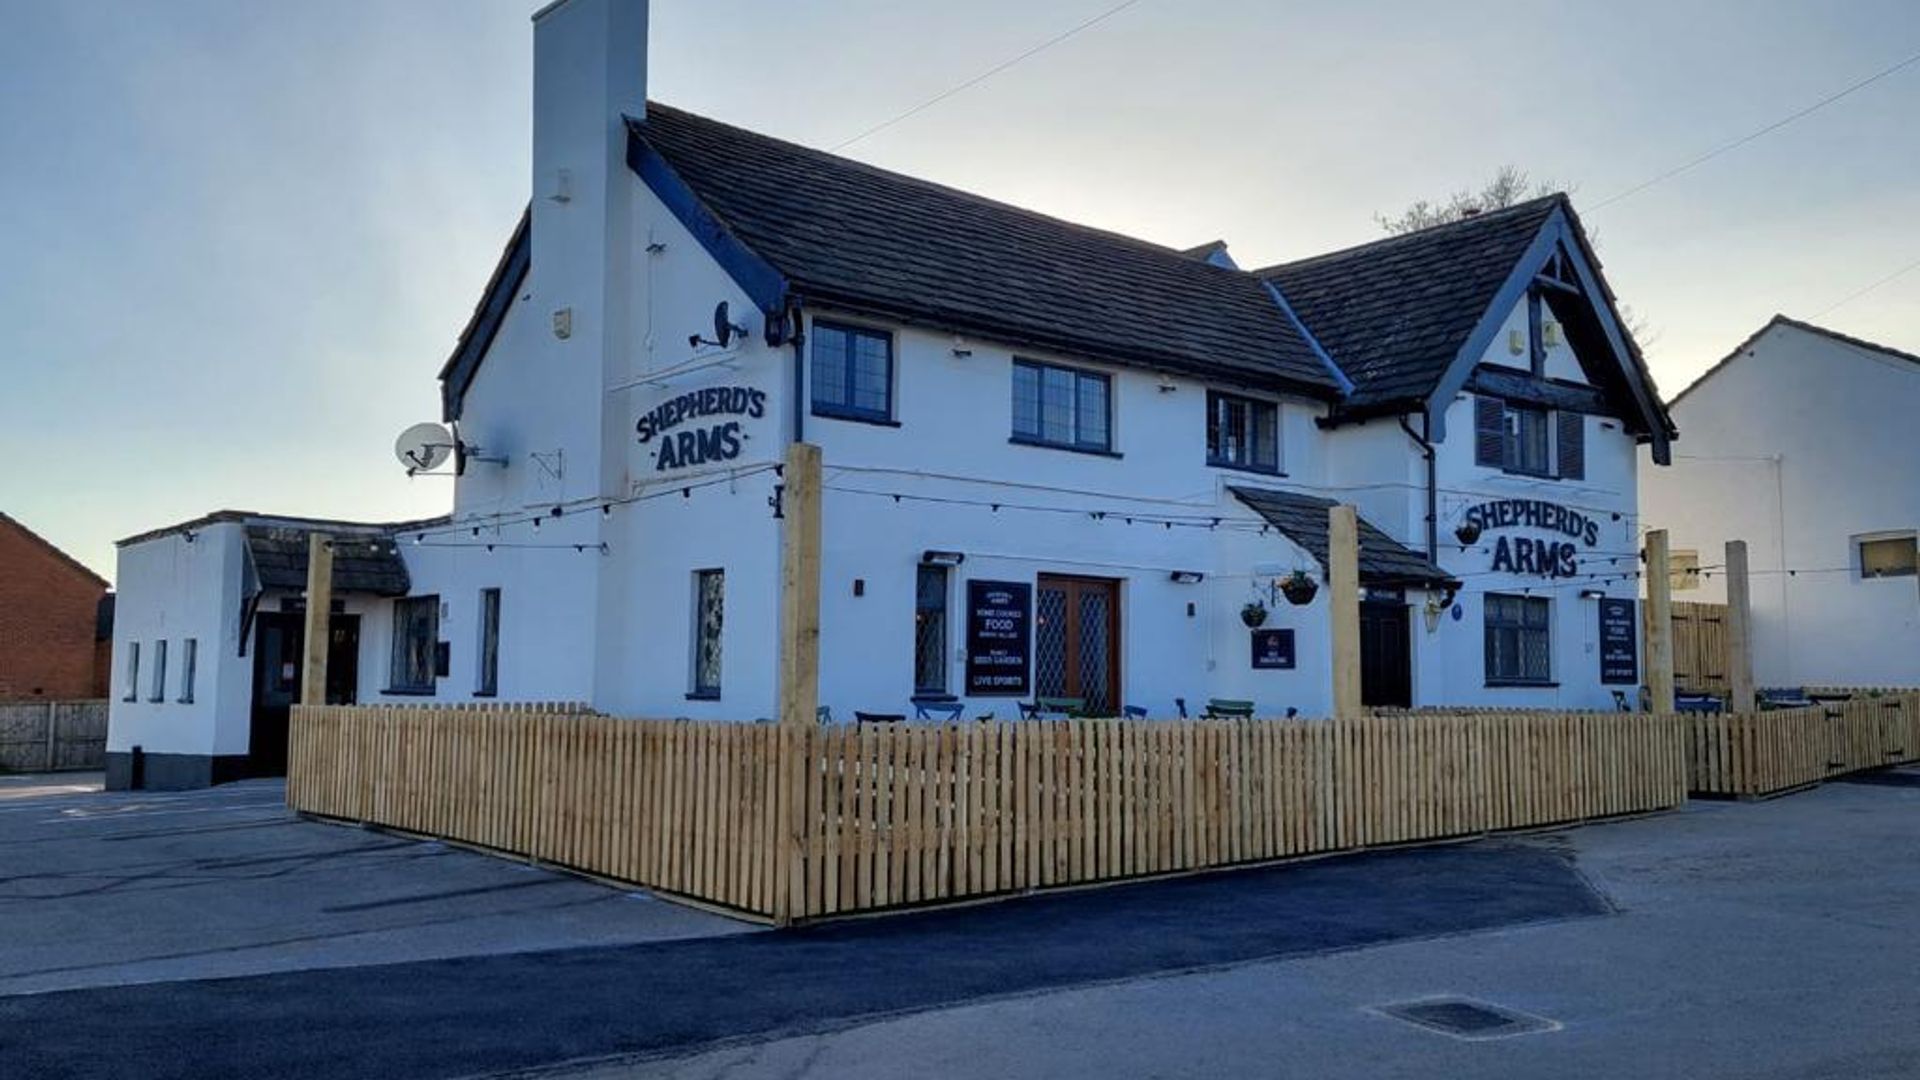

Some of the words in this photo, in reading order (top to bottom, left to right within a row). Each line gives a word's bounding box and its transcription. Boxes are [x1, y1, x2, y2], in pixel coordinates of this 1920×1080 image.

[636, 386, 766, 443] SHEPHERD'S
[656, 421, 740, 470] ARMS
[1466, 499, 1598, 547] SHEPHERD'S
[1491, 535, 1577, 578] ARMS
[985, 619, 1014, 630] FOOD
